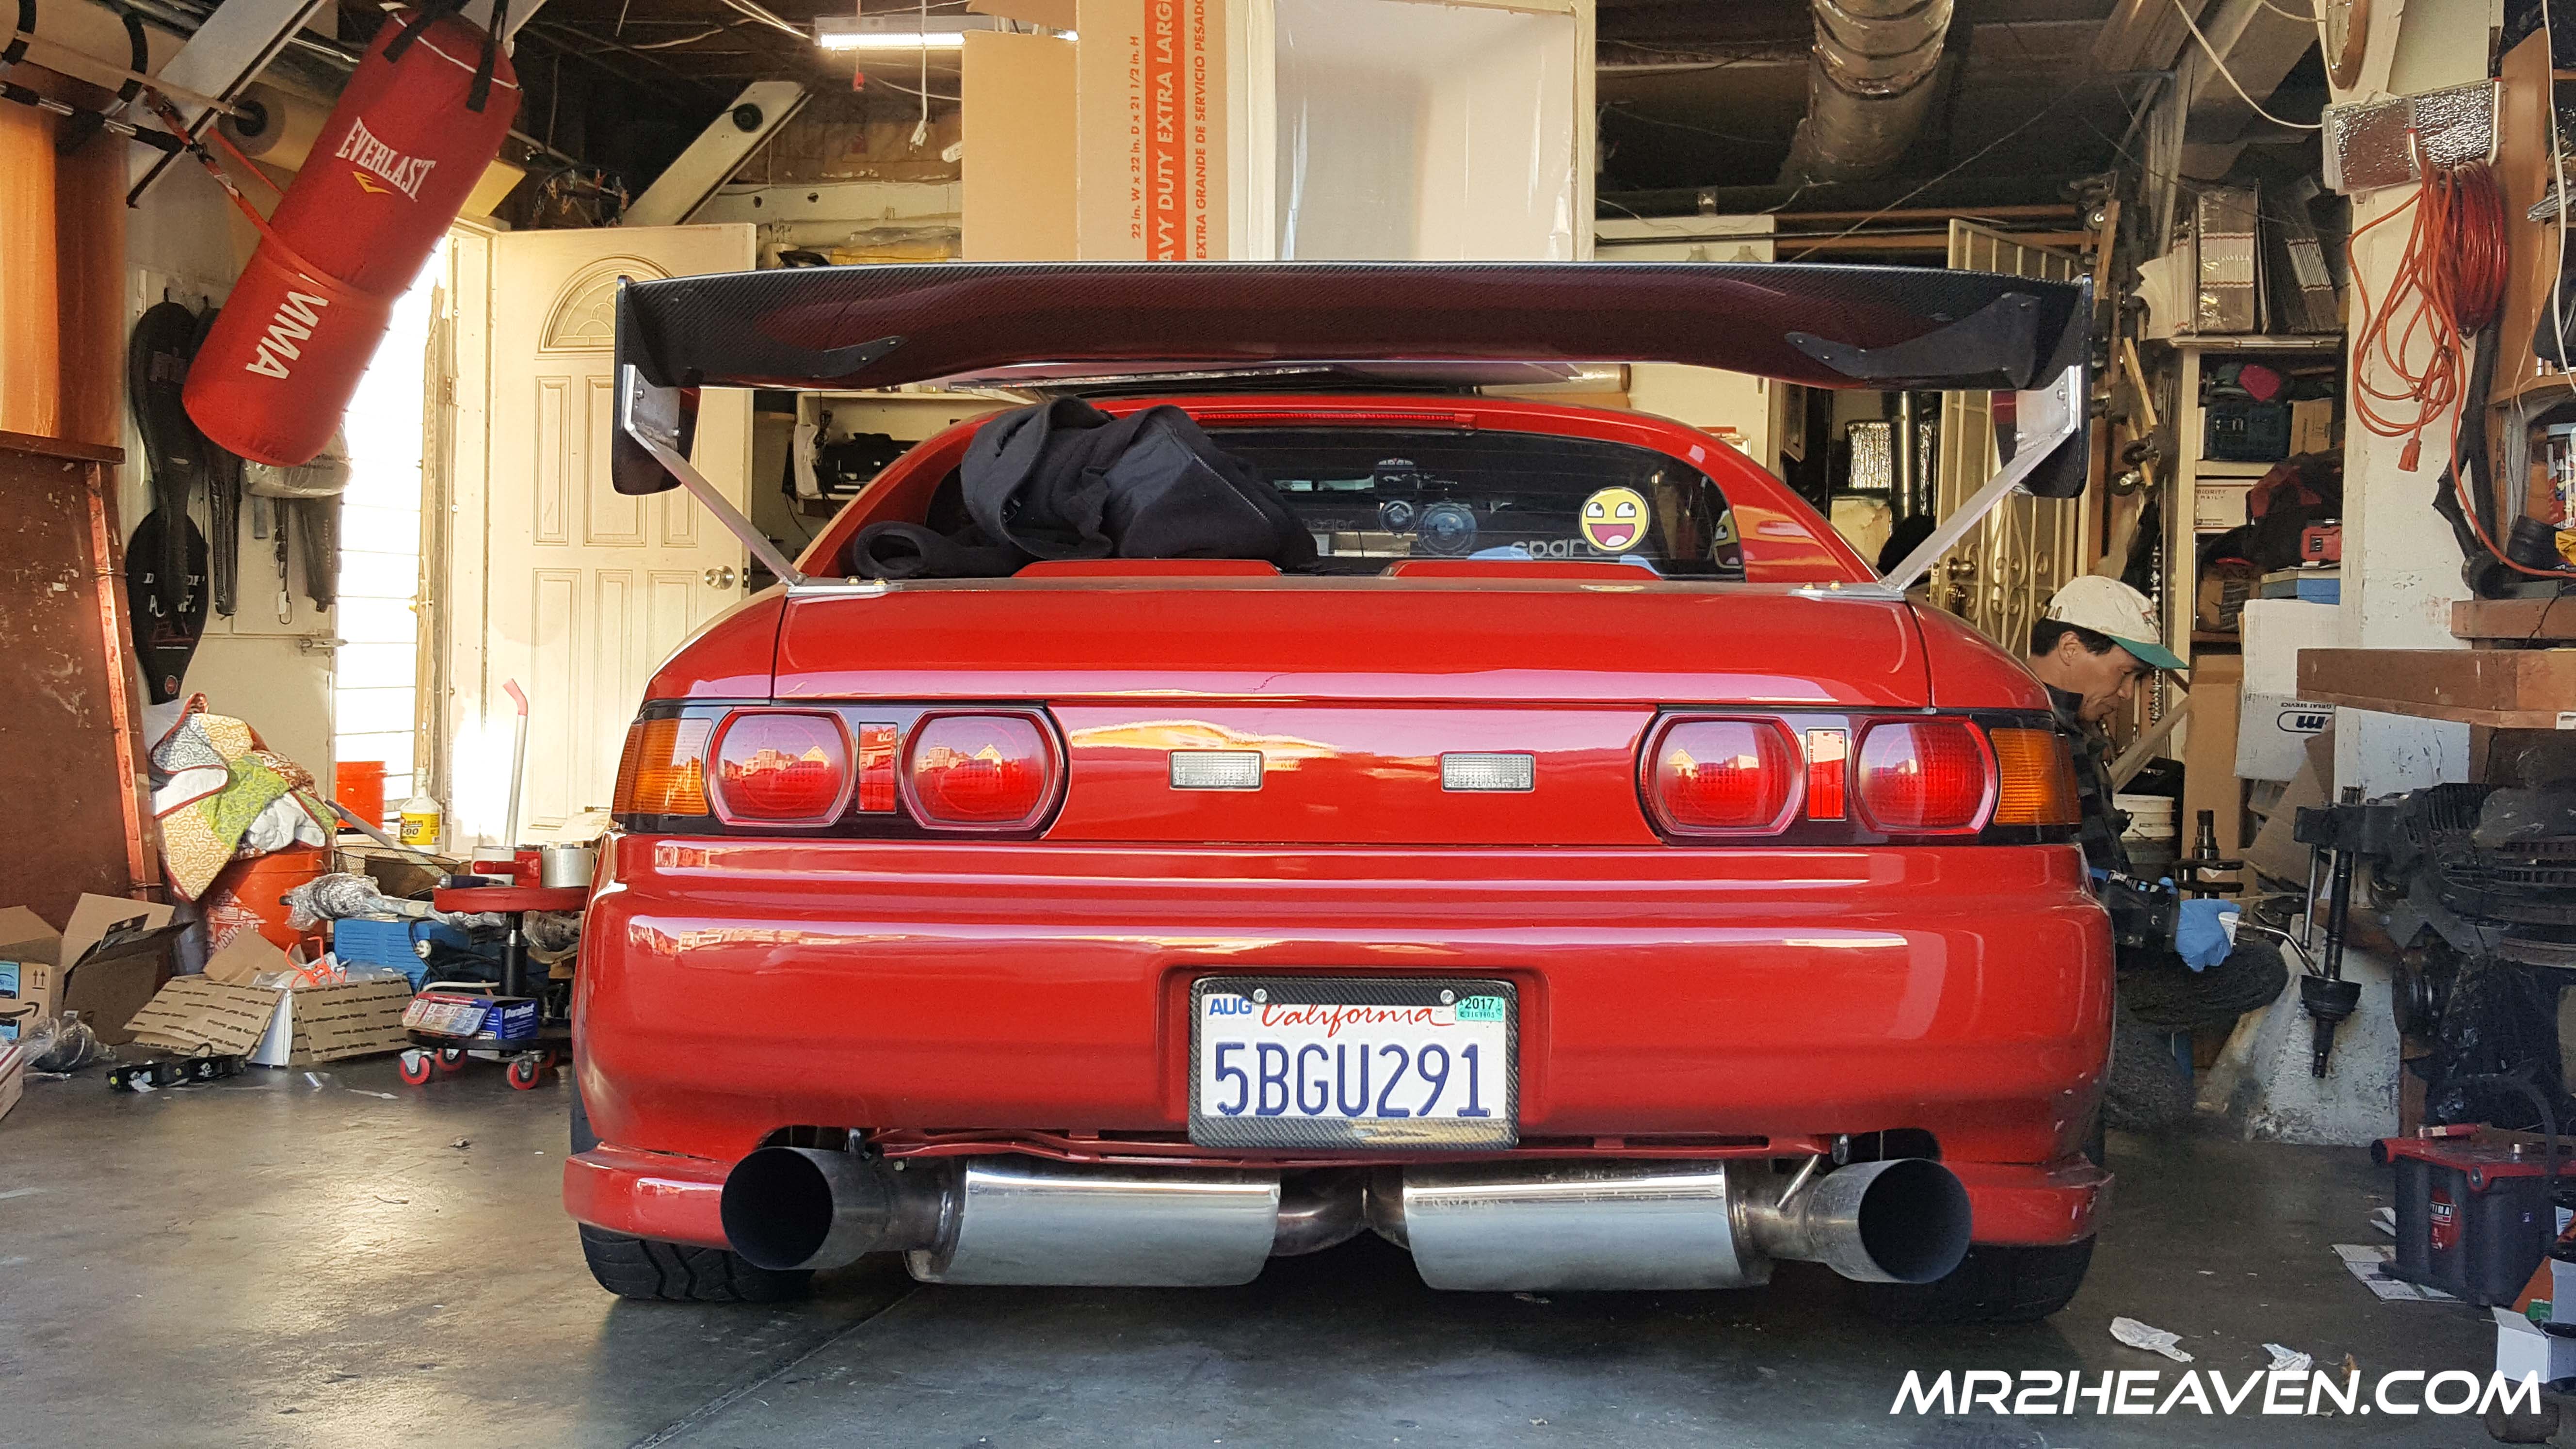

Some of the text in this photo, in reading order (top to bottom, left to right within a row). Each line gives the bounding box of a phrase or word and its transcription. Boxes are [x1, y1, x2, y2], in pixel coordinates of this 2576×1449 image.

[1130, 36, 1139, 46] H
[1156, 0, 1173, 64] LARG
[1129, 50, 1139, 64] in.
[1129, 68, 1140, 89] 1/2
[1194, 55, 1206, 122] SERVICIO
[1130, 96, 1140, 110] 21
[1156, 72, 1174, 143] EXTRA
[1131, 126, 1140, 135] D
[1195, 126, 1206, 143] DE
[1130, 139, 1140, 153] in.
[335, 116, 436, 200] EVERLAST
[1131, 157, 1140, 172] 22
[1157, 148, 1174, 210] DUTY
[1195, 147, 1206, 209] GRANDE
[1131, 188, 1140, 201] W
[1131, 205, 1141, 220] in.
[1131, 223, 1141, 239] 22
[1196, 214, 1207, 259] EXTRA
[245, 273, 329, 379] MMA
[1209, 997, 1253, 1016] AUG
[1465, 998, 1494, 1010] 2017
[1261, 1004, 1455, 1038] California
[1215, 1041, 1491, 1117] 5BGU291
